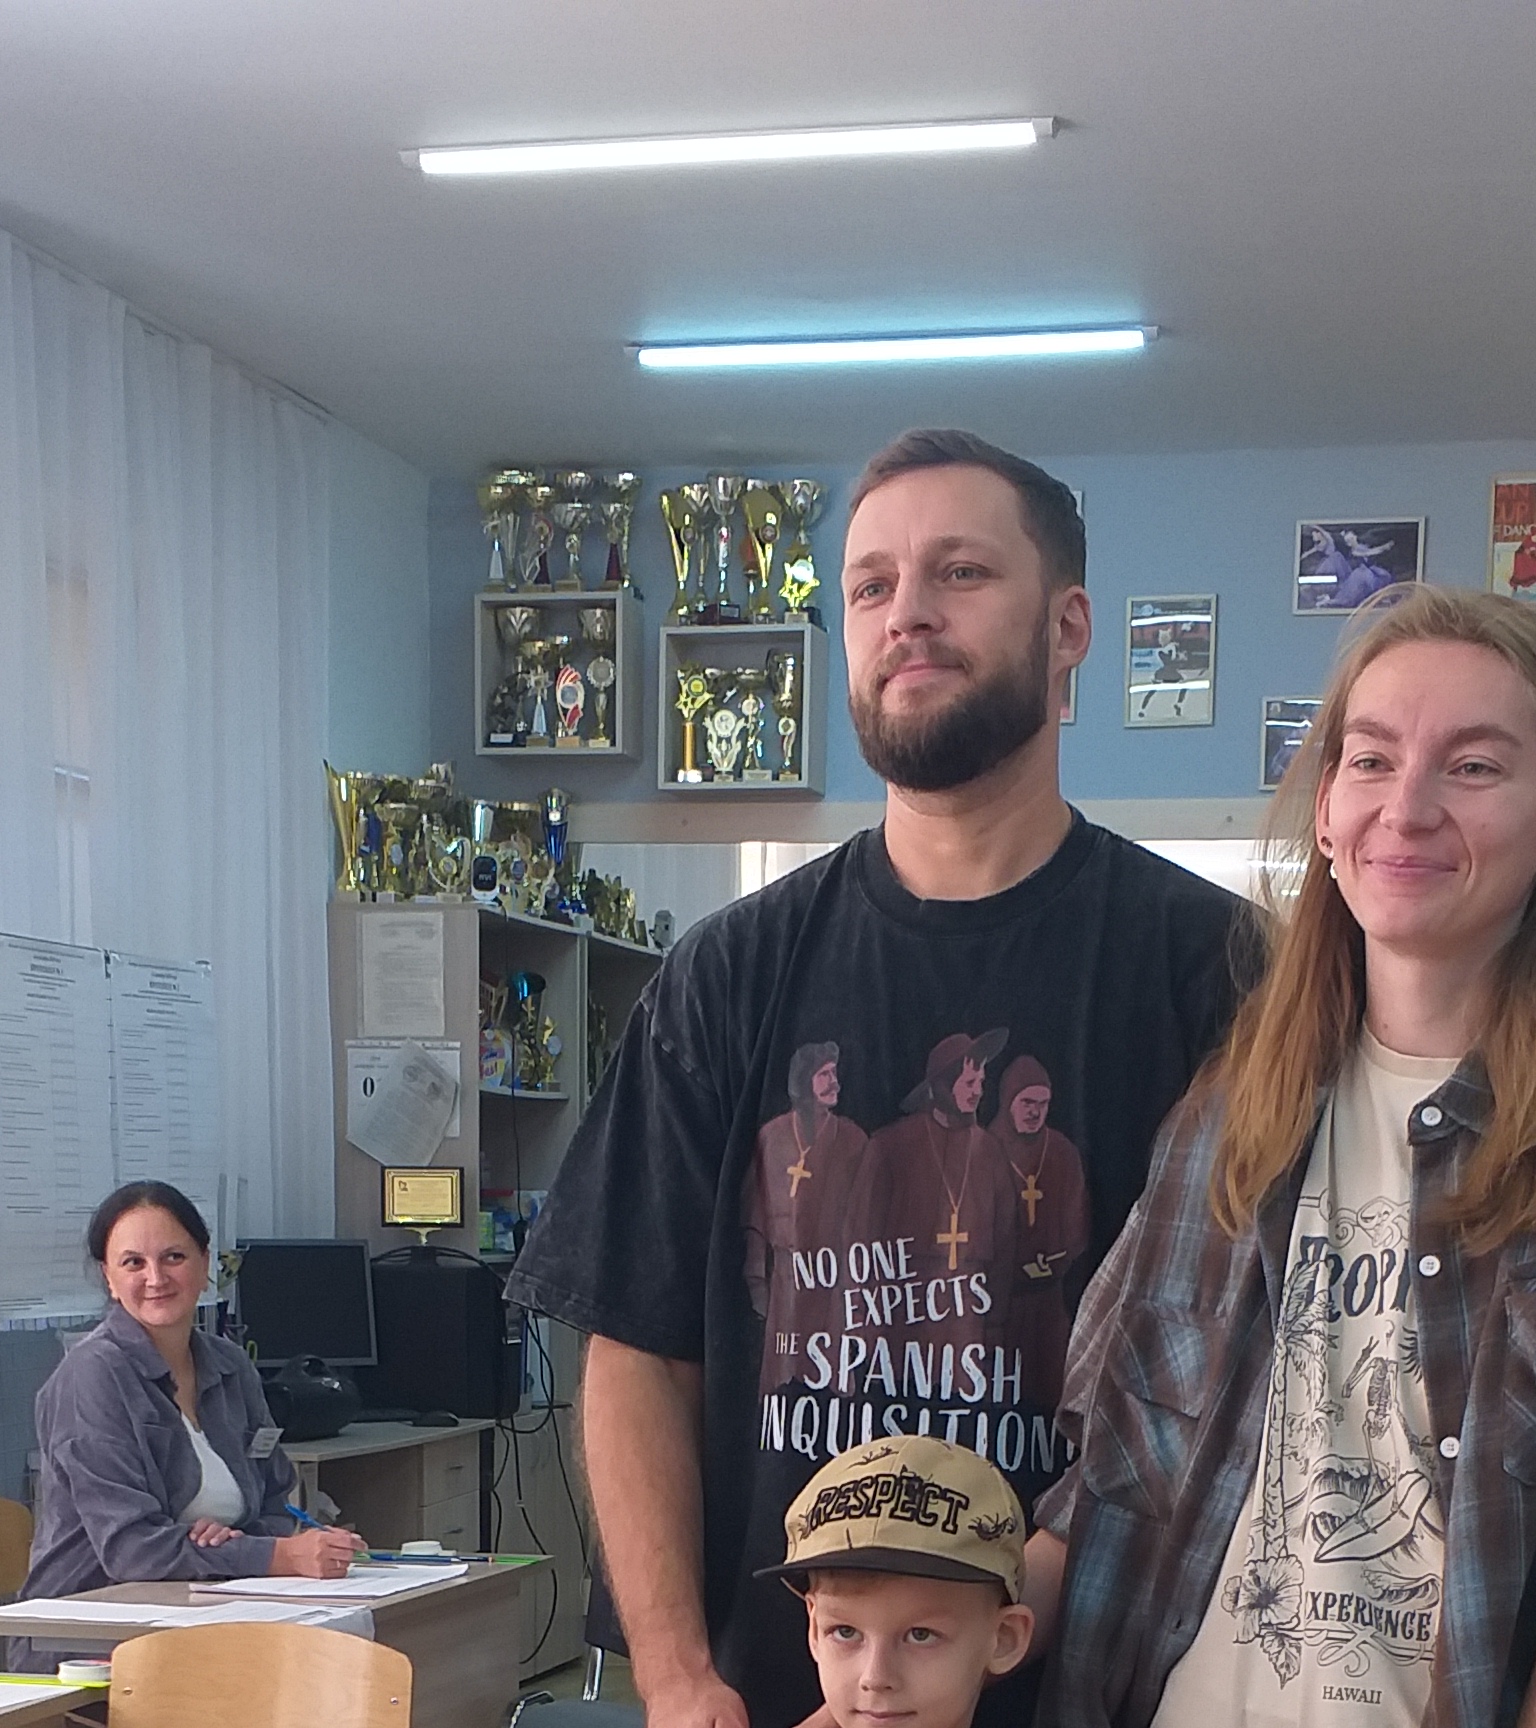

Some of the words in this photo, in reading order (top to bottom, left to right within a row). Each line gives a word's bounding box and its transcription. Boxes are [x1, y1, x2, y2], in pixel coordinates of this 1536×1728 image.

[792, 1247, 837, 1291] NO
[848, 1237, 918, 1284] ONE
[843, 1272, 992, 1331] EXPECTS
[775, 1332, 800, 1355] THE
[803, 1332, 1022, 1405] SPANISH
[809, 1471, 969, 1534] RESPECT
[1304, 1591, 1432, 1642] XPERIENCE
[1322, 1686, 1382, 1705] HAWAII
